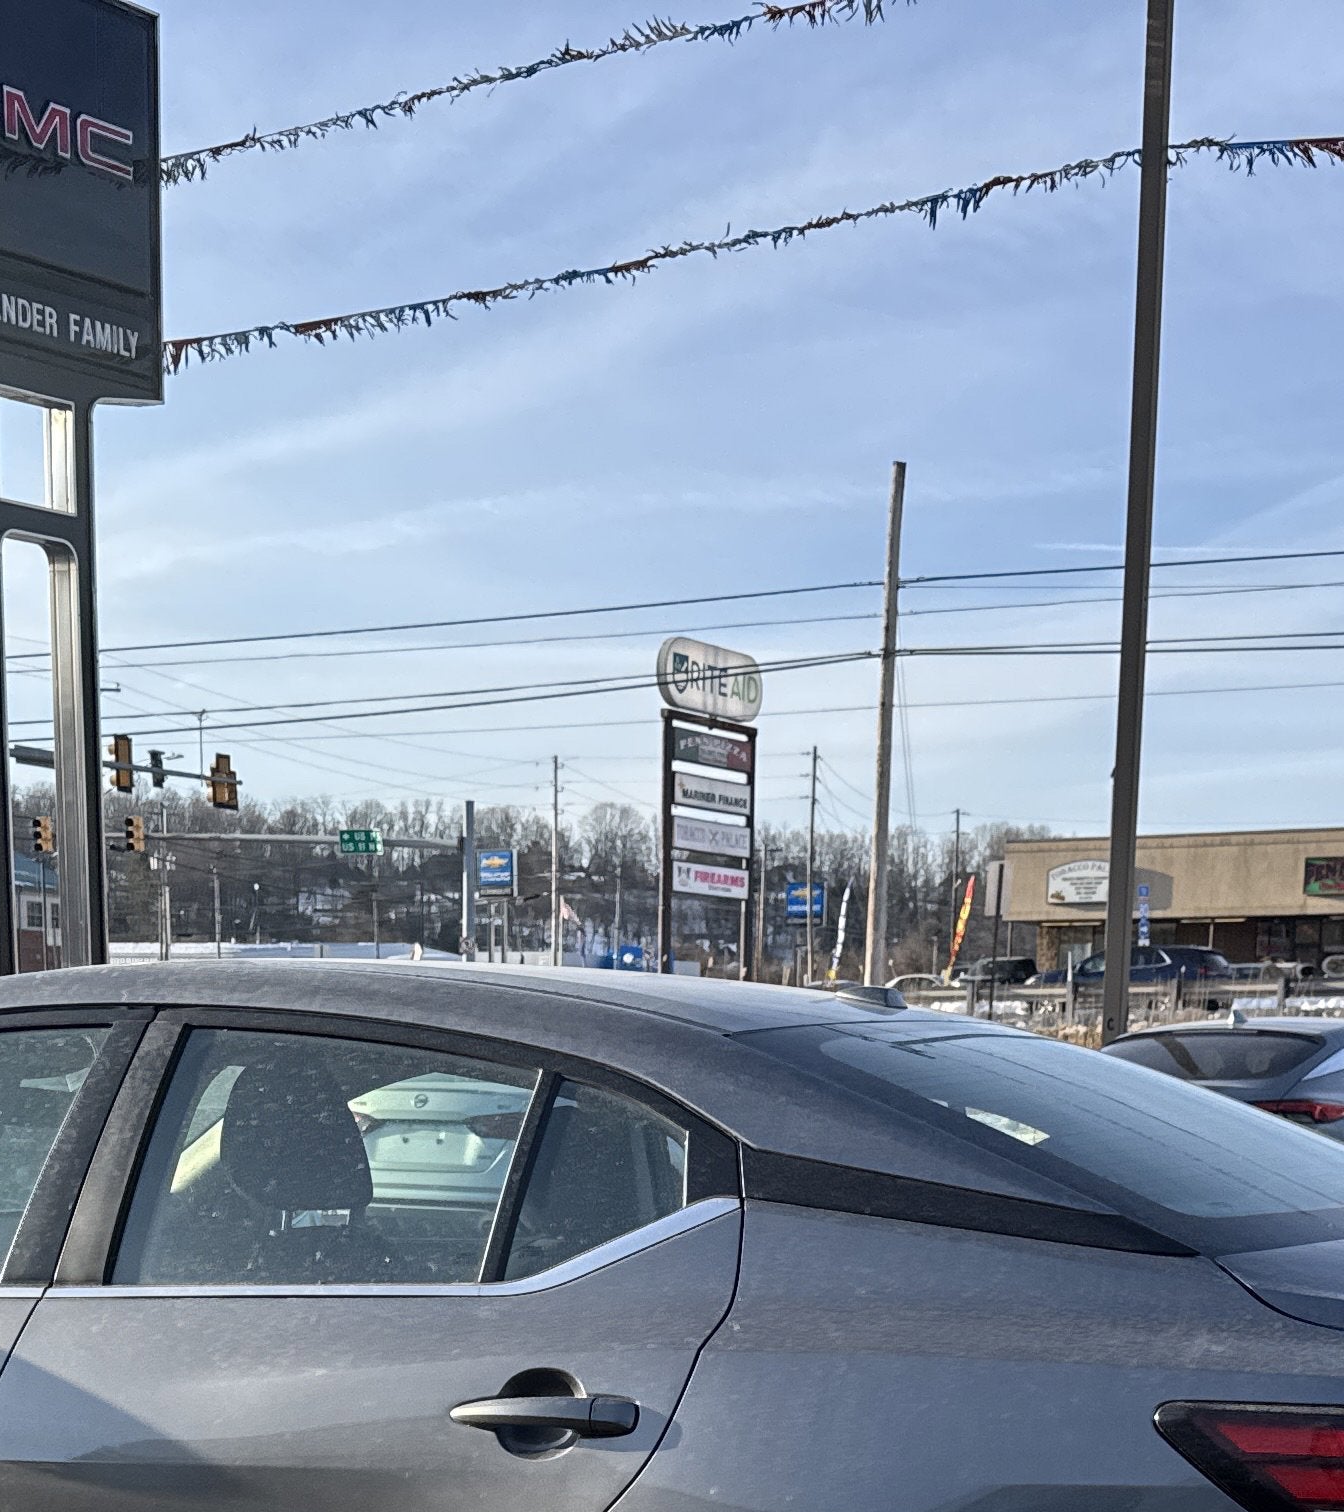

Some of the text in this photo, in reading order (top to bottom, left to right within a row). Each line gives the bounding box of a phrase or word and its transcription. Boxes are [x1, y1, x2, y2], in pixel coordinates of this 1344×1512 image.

[69, 312, 139, 359] FAMILY
[691, 660, 758, 703] RITE AID
[682, 788, 716, 803] MARINER
[694, 870, 746, 888] FIREARMS
